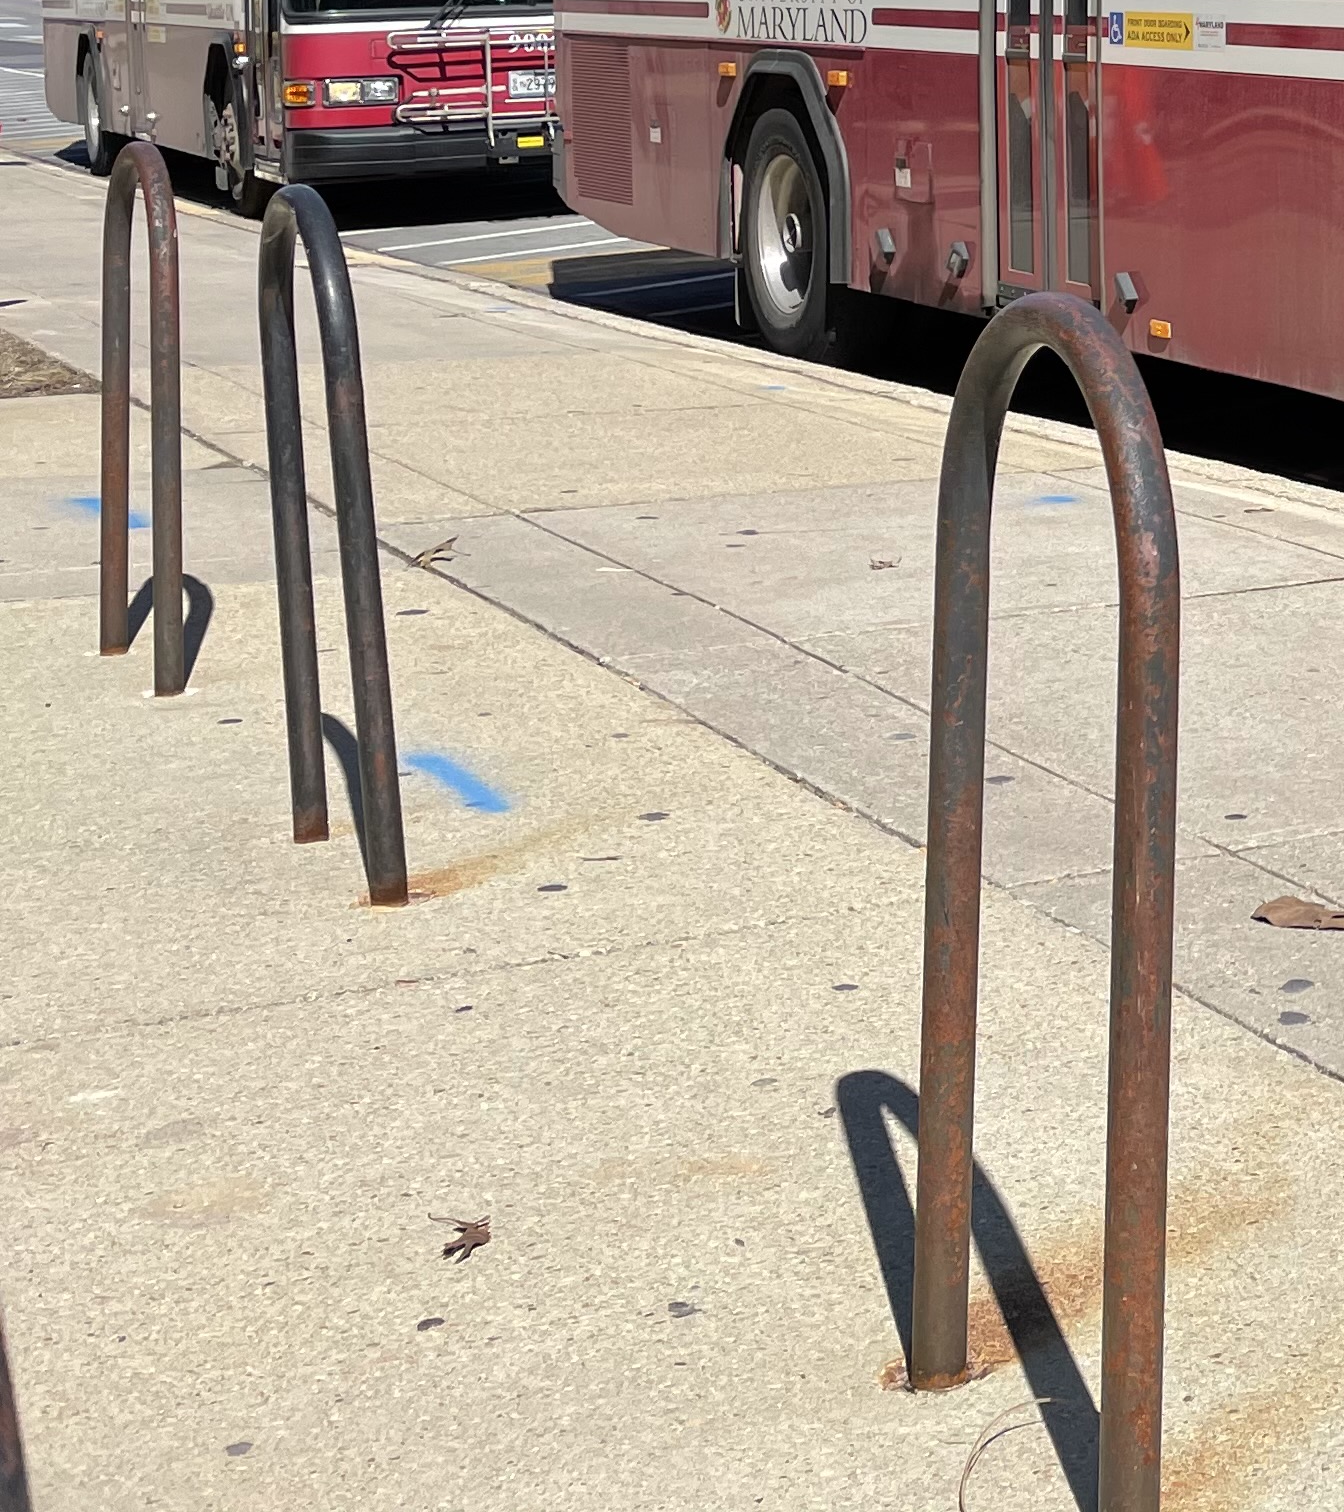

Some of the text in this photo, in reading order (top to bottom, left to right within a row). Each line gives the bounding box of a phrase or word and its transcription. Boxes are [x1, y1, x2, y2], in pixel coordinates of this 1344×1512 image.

[736, 5, 867, 43] MARYLAND
[1127, 31, 1182, 43] ADA ACCESS ONLY
